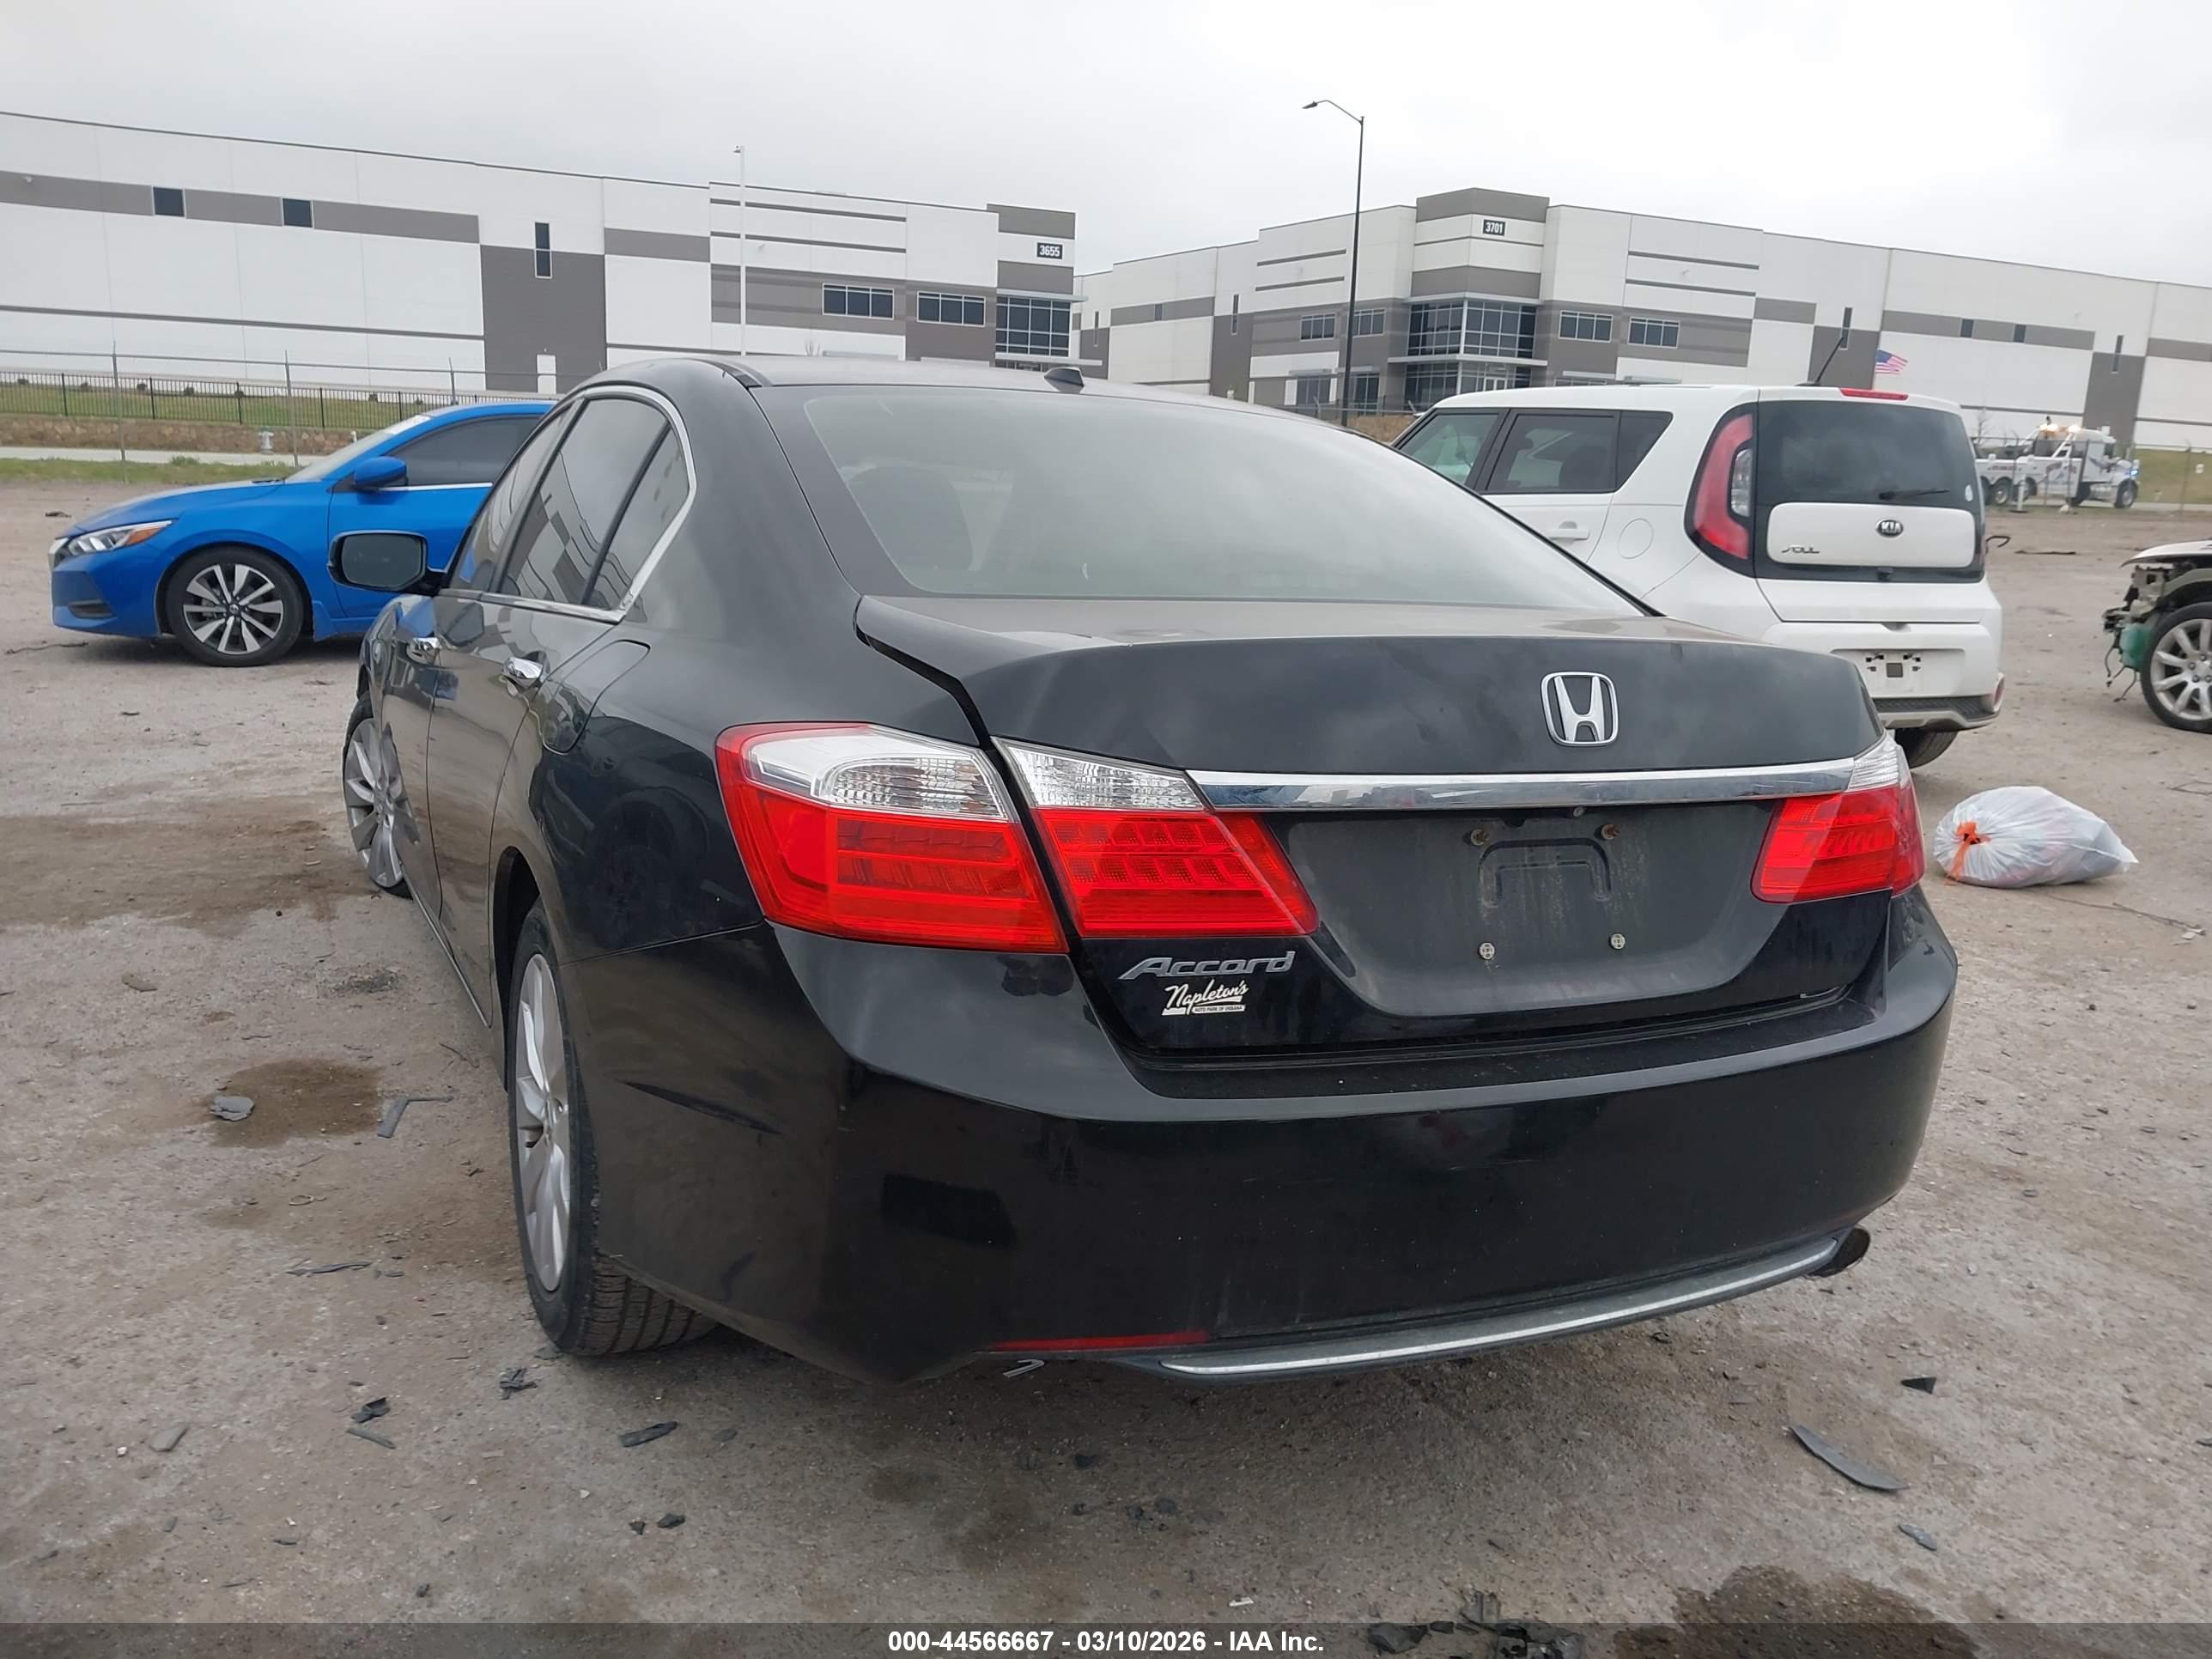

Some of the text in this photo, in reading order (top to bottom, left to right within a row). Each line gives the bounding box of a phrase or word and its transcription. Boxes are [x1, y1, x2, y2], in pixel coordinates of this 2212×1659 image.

[1486, 222, 1503, 234] 3701
[1039, 245, 1060, 258] 3655
[1881, 521, 1902, 533] KIA
[1118, 951, 1296, 980] Accord
[1164, 979, 1249, 1015] Napleton's
